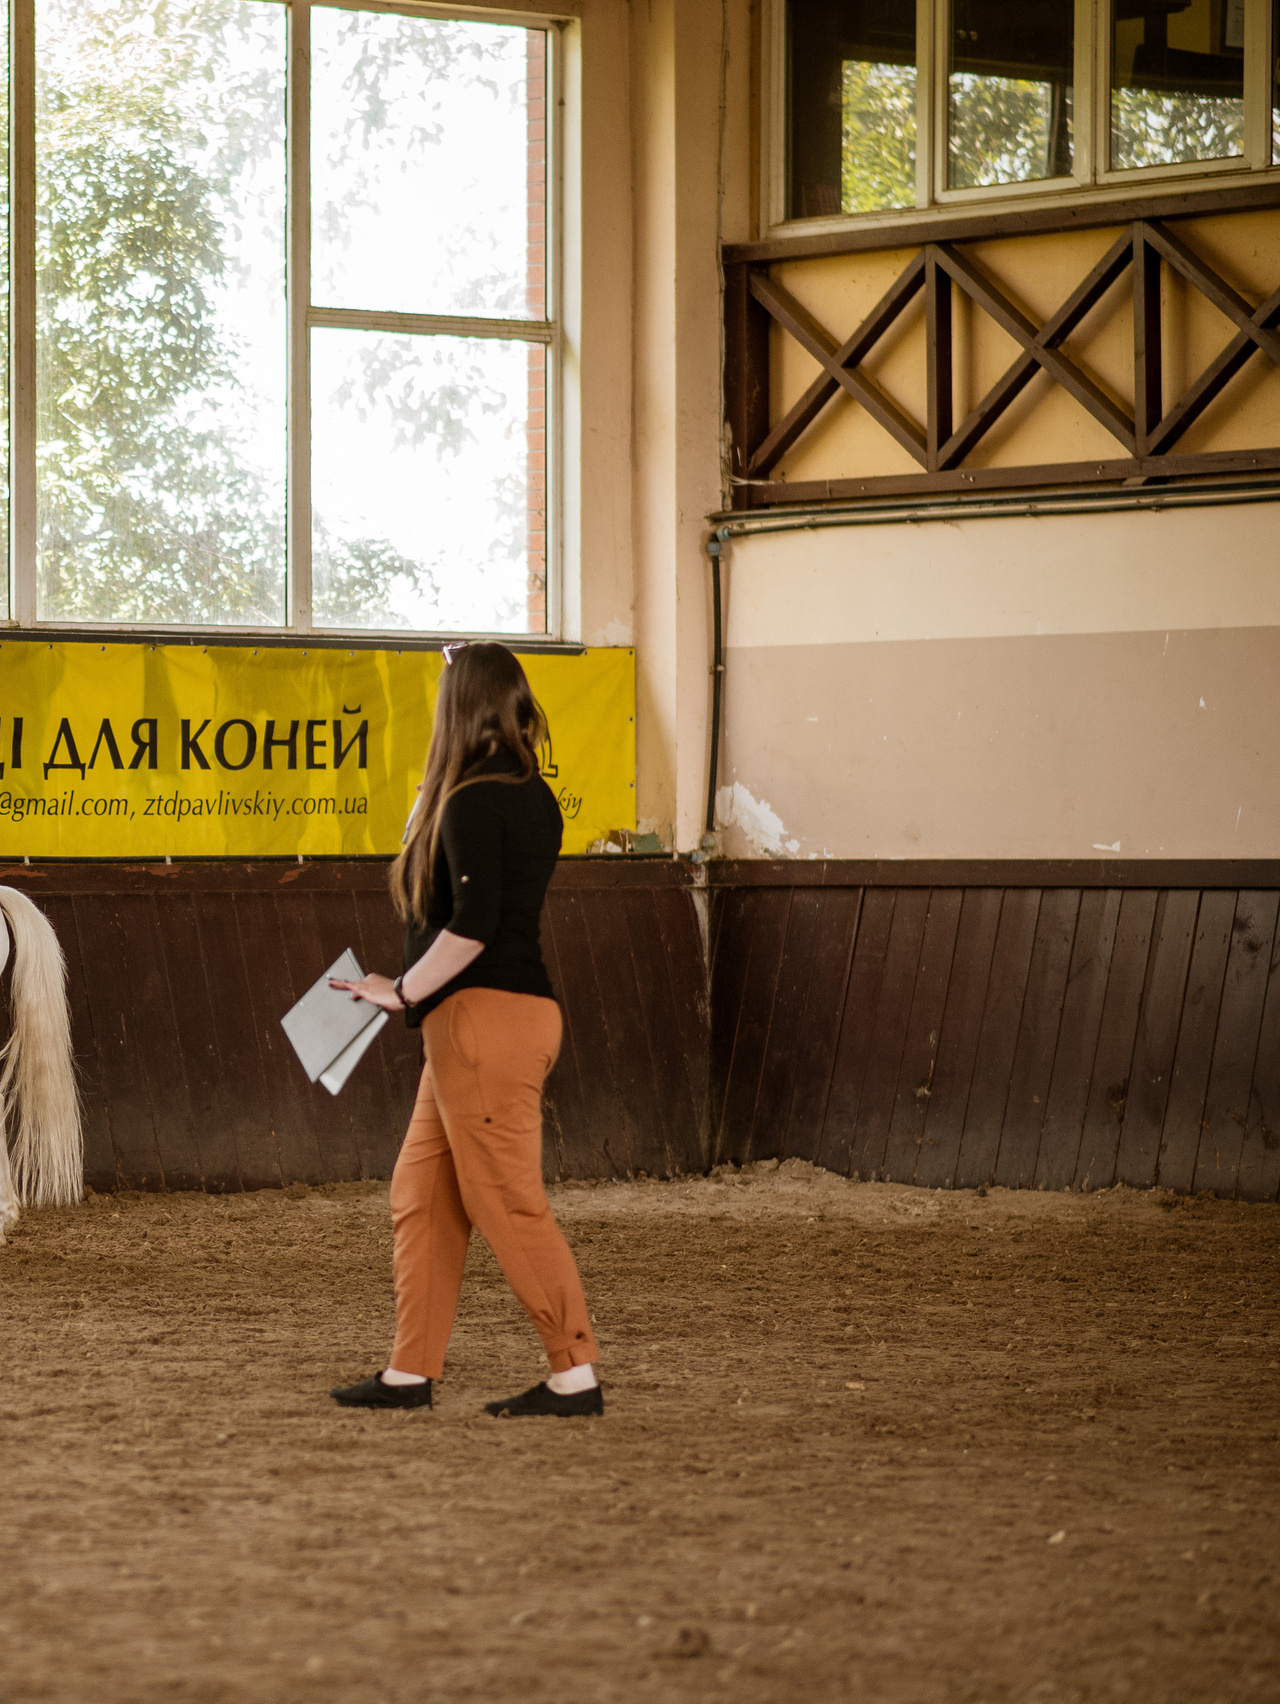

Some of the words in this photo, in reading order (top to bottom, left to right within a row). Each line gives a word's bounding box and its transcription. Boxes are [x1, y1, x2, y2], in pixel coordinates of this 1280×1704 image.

[43, 717, 158, 781] ДЛЯ
[180, 703, 369, 771] КОНЕЙ
[143, 790, 369, 822] ztdpavlivskiy.com.ua
